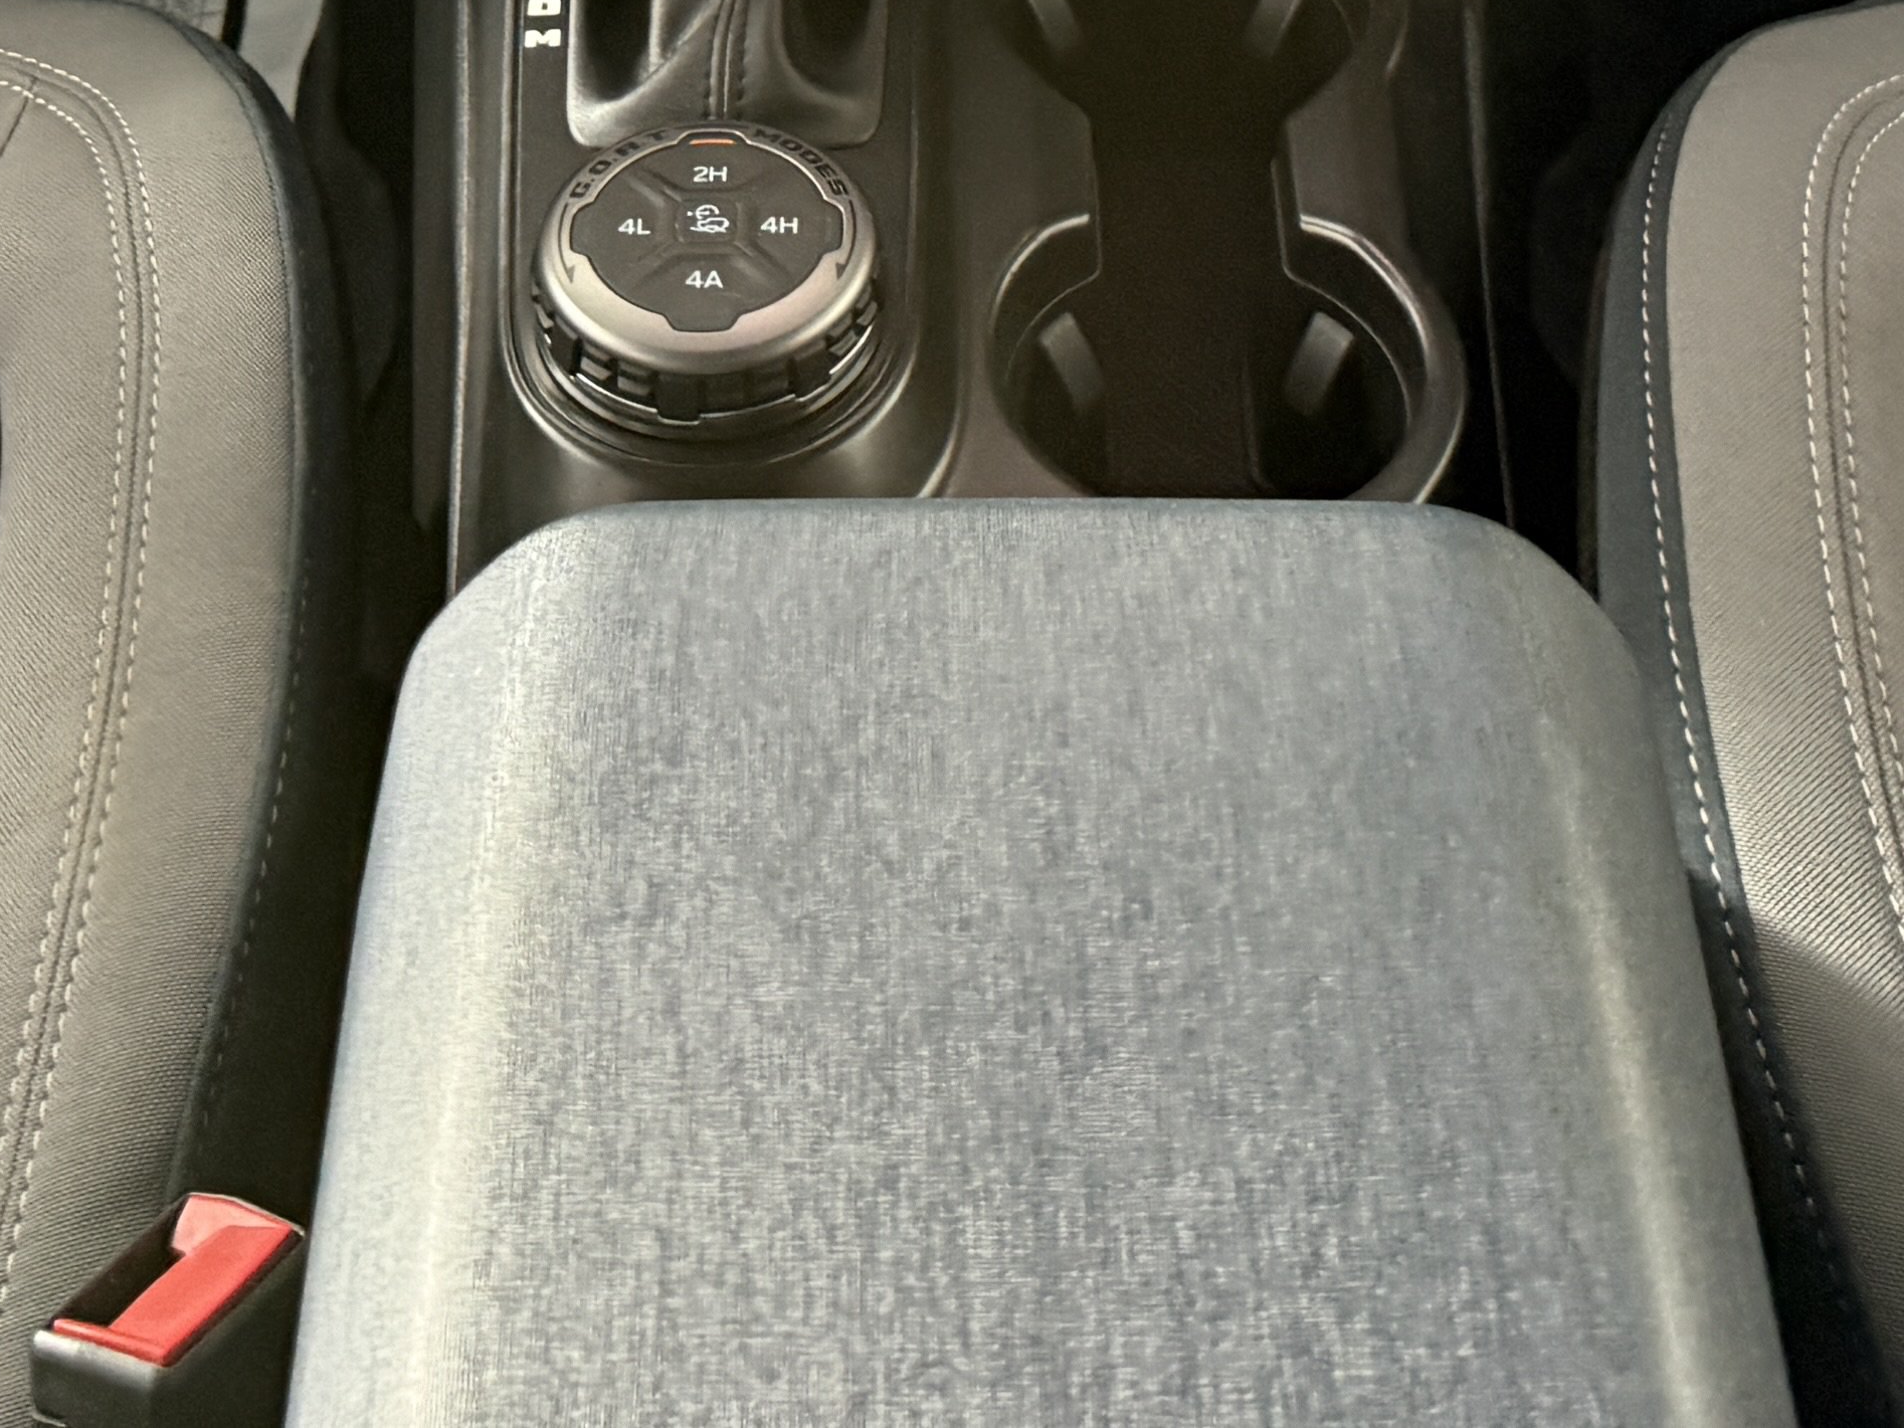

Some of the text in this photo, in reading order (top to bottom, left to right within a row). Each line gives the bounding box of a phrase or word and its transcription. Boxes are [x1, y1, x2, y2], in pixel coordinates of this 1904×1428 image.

[524, 28, 561, 48] M
[754, 129, 849, 197] MODES
[693, 166, 728, 183] 2H
[618, 218, 651, 235] 4L
[760, 217, 798, 234] 4H
[686, 270, 724, 288] 4A
